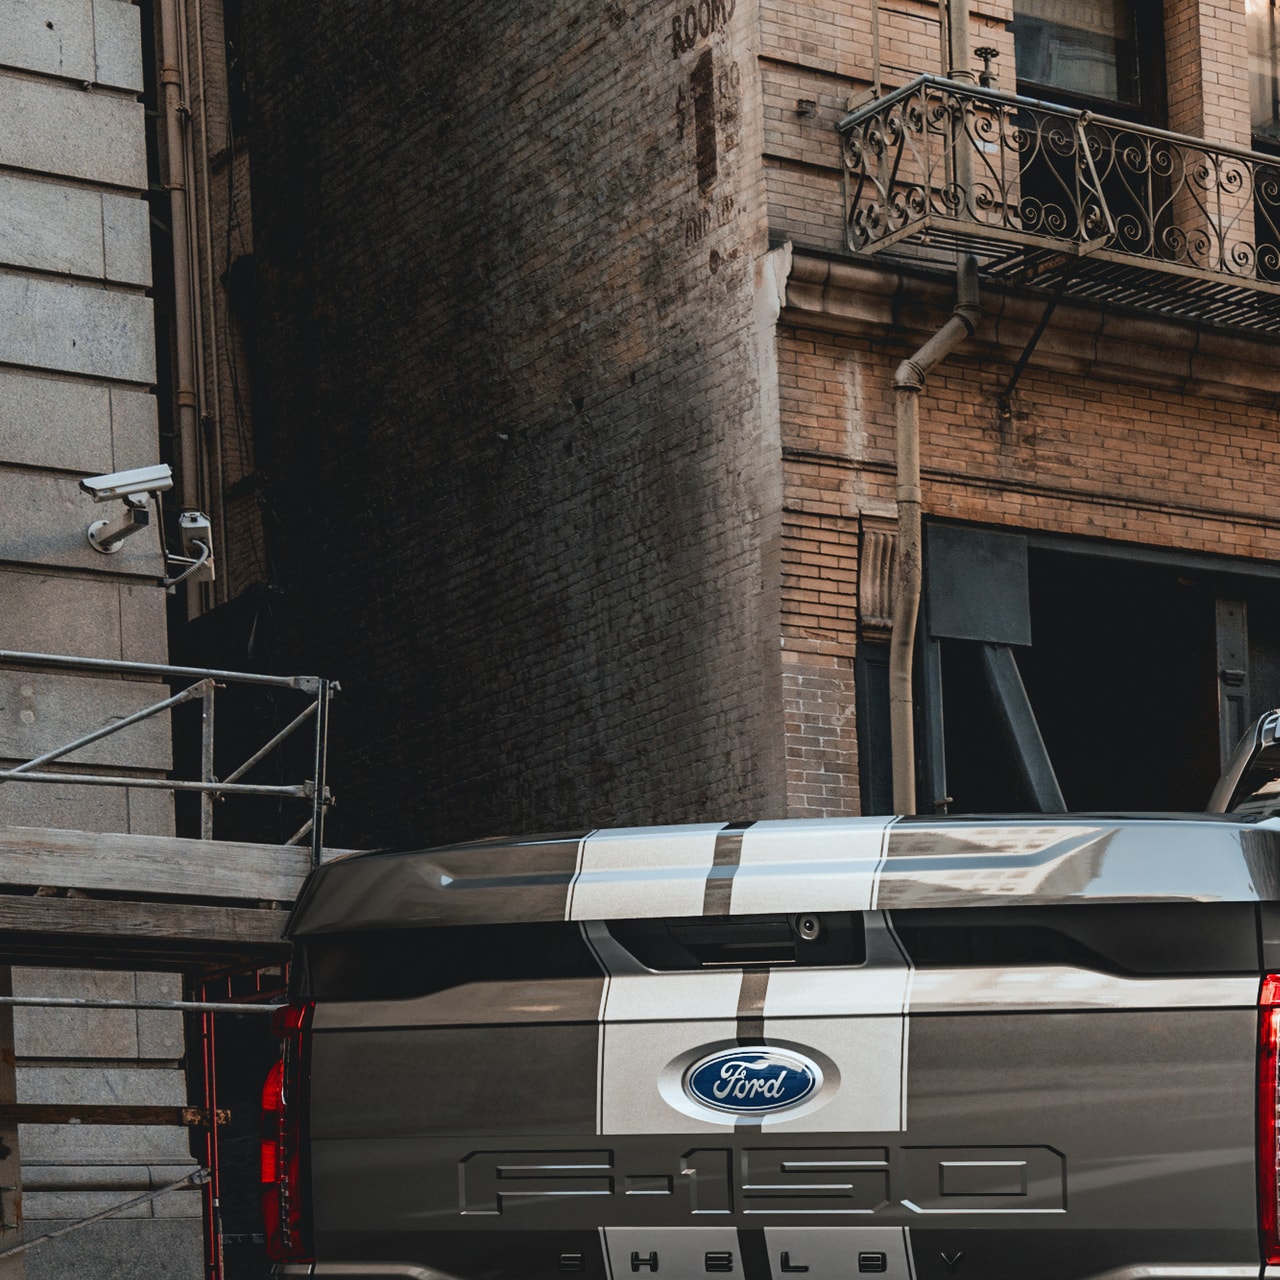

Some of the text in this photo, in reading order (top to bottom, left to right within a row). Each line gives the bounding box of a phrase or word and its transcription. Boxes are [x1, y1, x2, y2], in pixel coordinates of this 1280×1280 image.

[713, 1061, 788, 1100] Ford
[457, 1145, 1067, 1215] F-150
[558, 1250, 965, 1275] SHELBY
